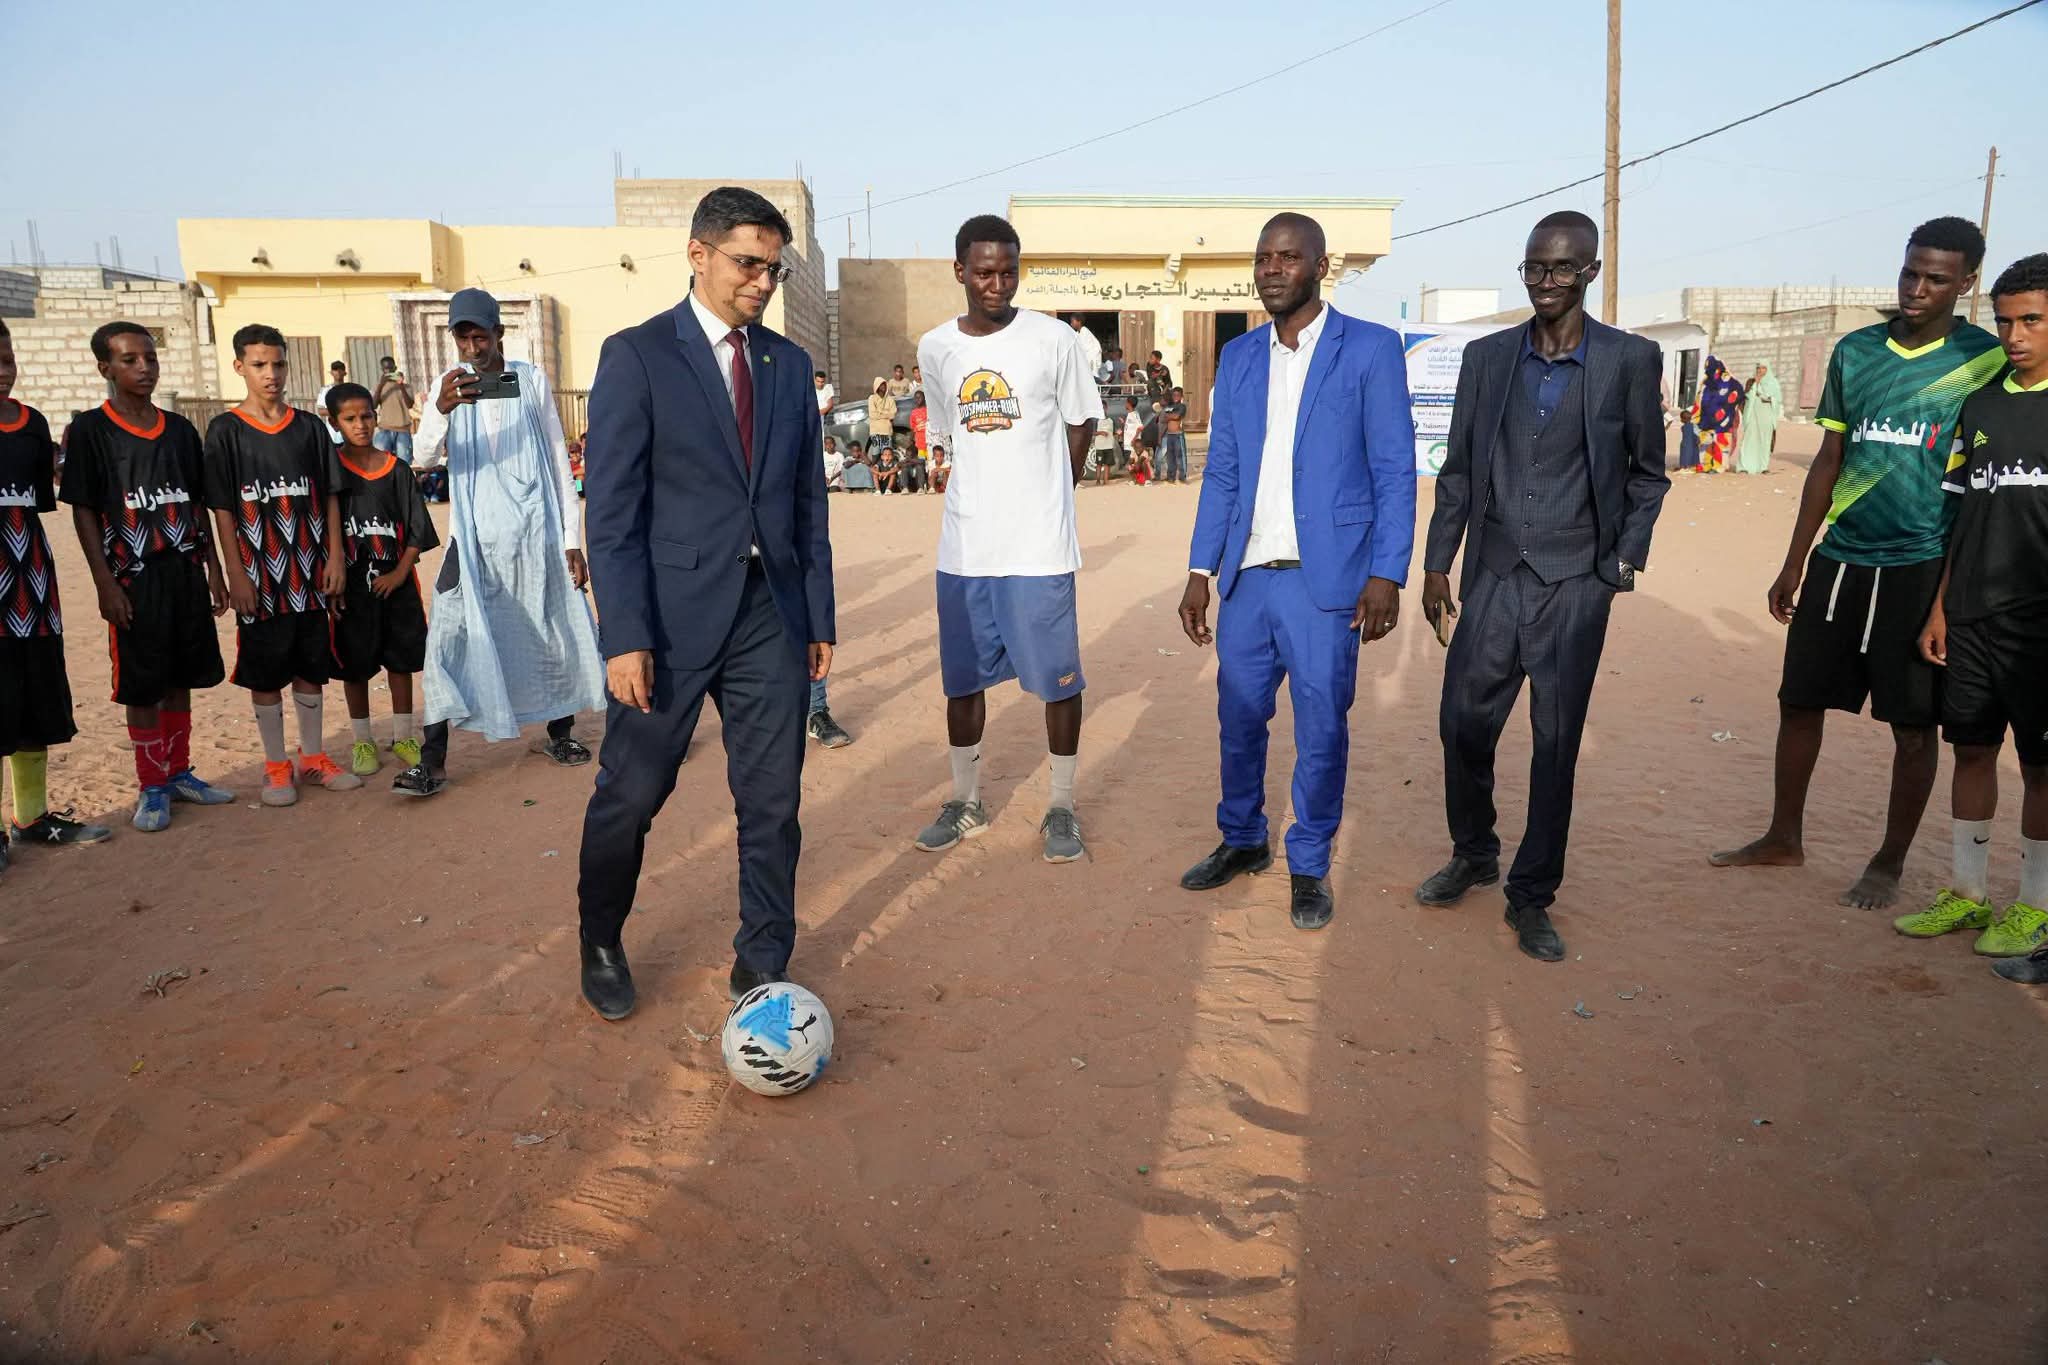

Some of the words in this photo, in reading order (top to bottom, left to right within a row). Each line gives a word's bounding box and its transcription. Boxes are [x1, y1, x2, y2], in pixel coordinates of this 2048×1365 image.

[1100, 282, 1187, 300] التجاري
[1190, 282, 1255, 301] التيسير
[241, 475, 309, 503] للمخدرات
[1970, 458, 2048, 494] مخدرات
[0, 483, 37, 507] للمخد
[125, 482, 190, 511] مخدرات
